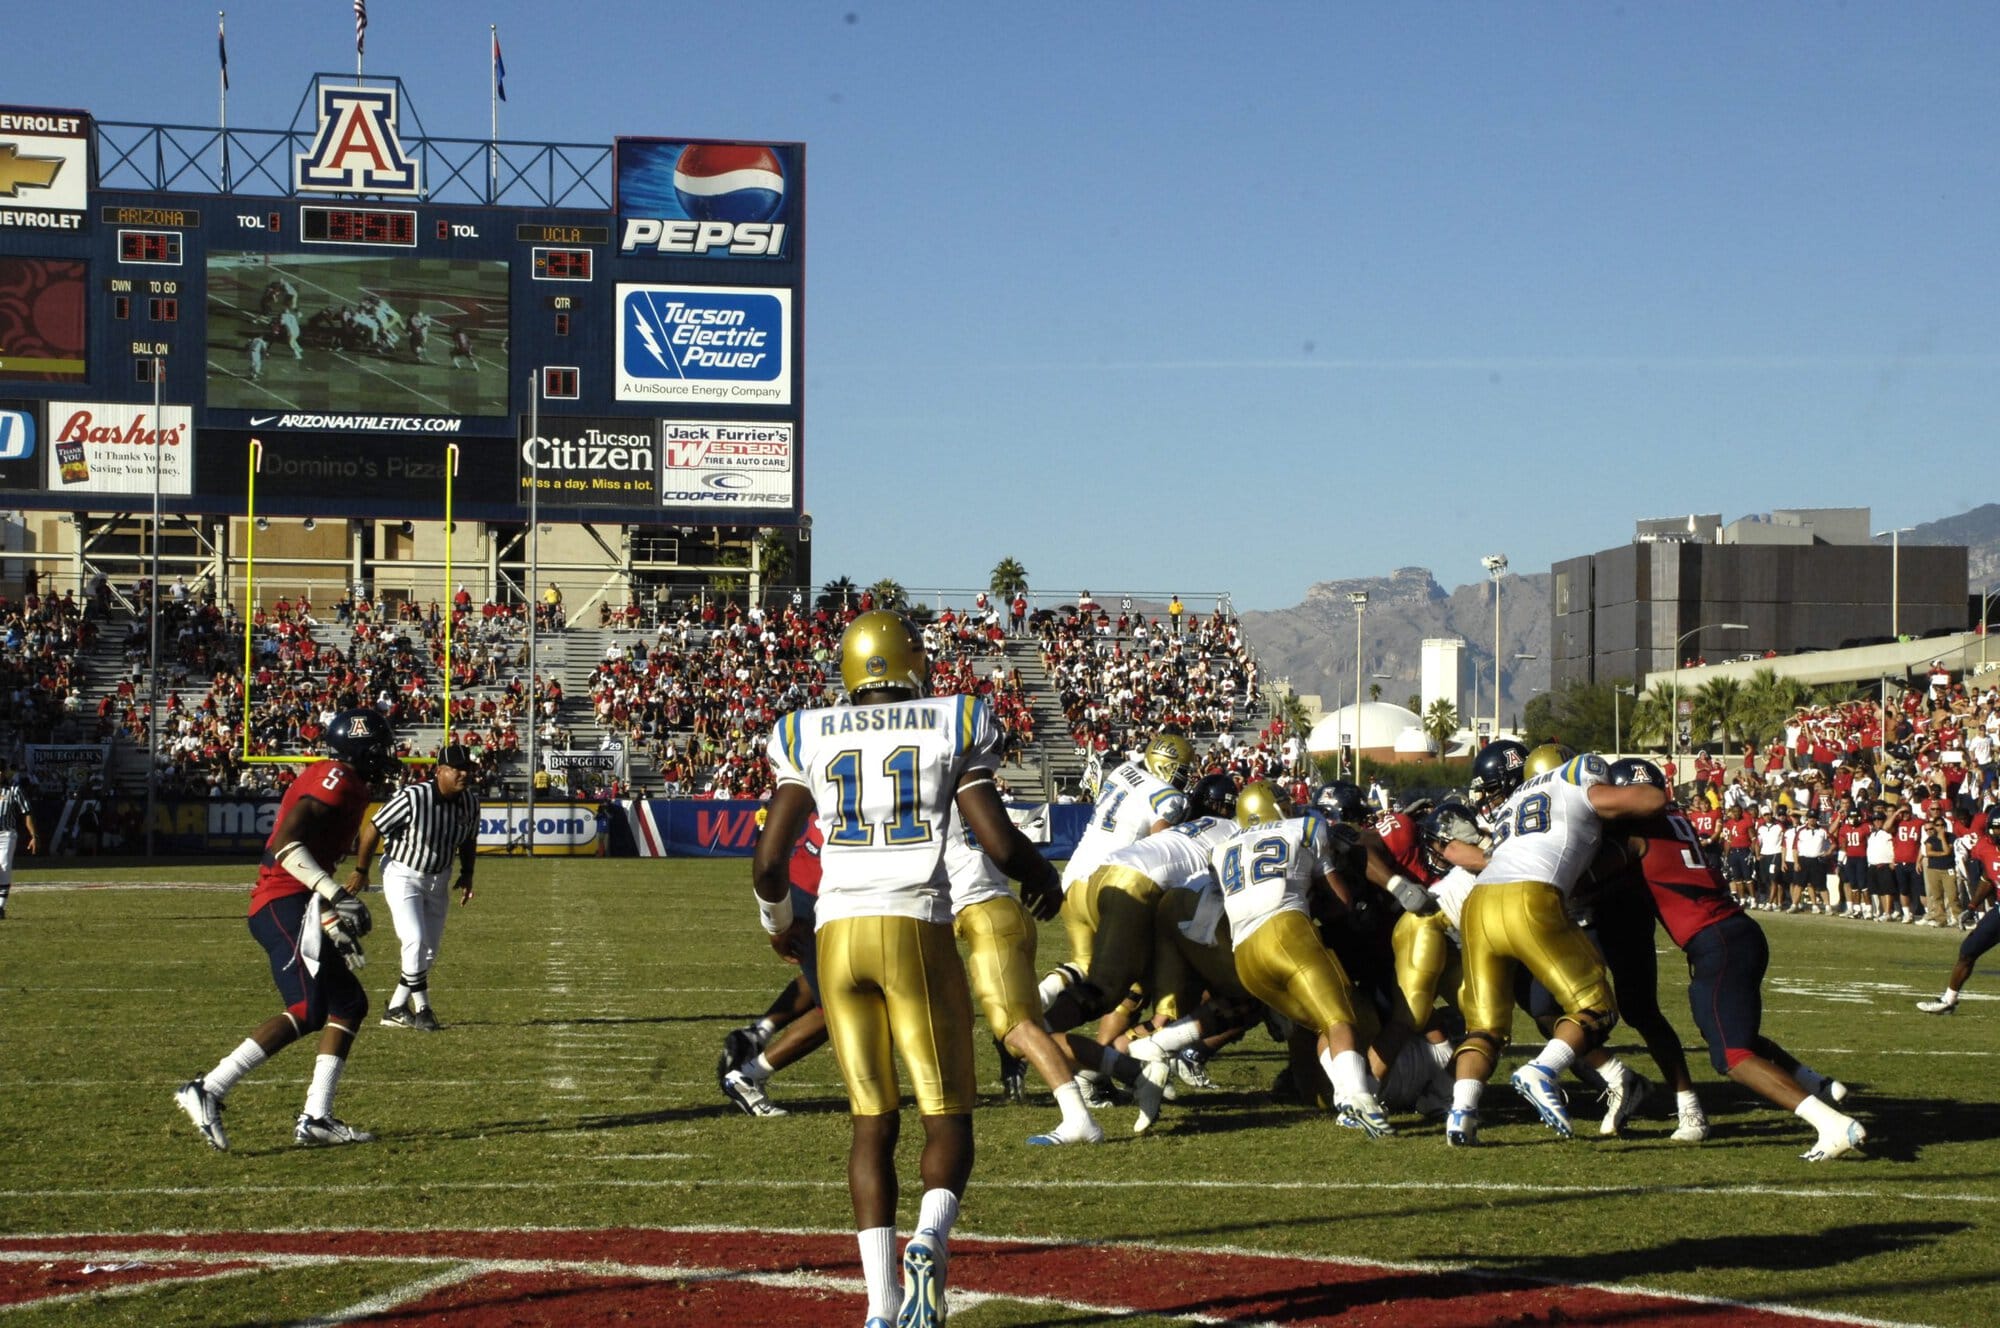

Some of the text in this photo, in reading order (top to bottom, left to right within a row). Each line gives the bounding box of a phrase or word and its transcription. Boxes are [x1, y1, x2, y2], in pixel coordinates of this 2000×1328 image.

[296, 85, 420, 196] A
[0, 212, 81, 229] EVROLET
[118, 207, 184, 227] ARIZONA
[237, 215, 265, 229] TOL
[452, 225, 479, 238] TOL
[543, 227, 581, 242] UCLA
[621, 218, 787, 256] PEPSI
[111, 279, 131, 292] DWN
[150, 281, 177, 294] TO GO
[554, 297, 571, 309] QTR
[664, 302, 745, 326] Tucson
[672, 325, 767, 347] Electric
[133, 342, 168, 354] BALL ON
[682, 346, 766, 368] Power
[623, 383, 781, 399] A UniSource Energy Company
[55, 410, 186, 446] Bashas'
[278, 414, 461, 432] ARIZONAATHLETICS.COM
[585, 429, 651, 447] Tucson
[668, 428, 788, 442] Jack Furrier's
[63, 454, 81, 462] YOU
[105, 451, 140, 461] Thanks
[164, 453, 177, 463] By
[522, 437, 654, 471] Citizen
[668, 440, 788, 467] WESTERN
[265, 454, 378, 477] Domino's
[705, 456, 724, 465] TIRE
[736, 457, 760, 466] AUTO
[762, 458, 786, 467] CARE
[90, 465, 122, 475] Saving
[125, 465, 143, 474] You
[522, 477, 654, 491] Mss a day. Miss a lot.
[792, 593, 802, 604] 29
[1122, 599, 1131, 609] 30
[348, 716, 373, 738] A
[821, 707, 937, 737] RASSHAN
[609, 742, 622, 751] 29
[1074, 748, 1087, 756] 30
[552, 756, 614, 769] BRUEGGER'S
[1502, 749, 1523, 771] A
[321, 767, 345, 790] 5
[1630, 765, 1653, 783] A
[826, 745, 933, 846] 11
[1697, 816, 1712, 831] 72
[1846, 832, 1860, 846] 10
[1898, 826, 1918, 841] 64
[1222, 836, 1290, 897] 42
